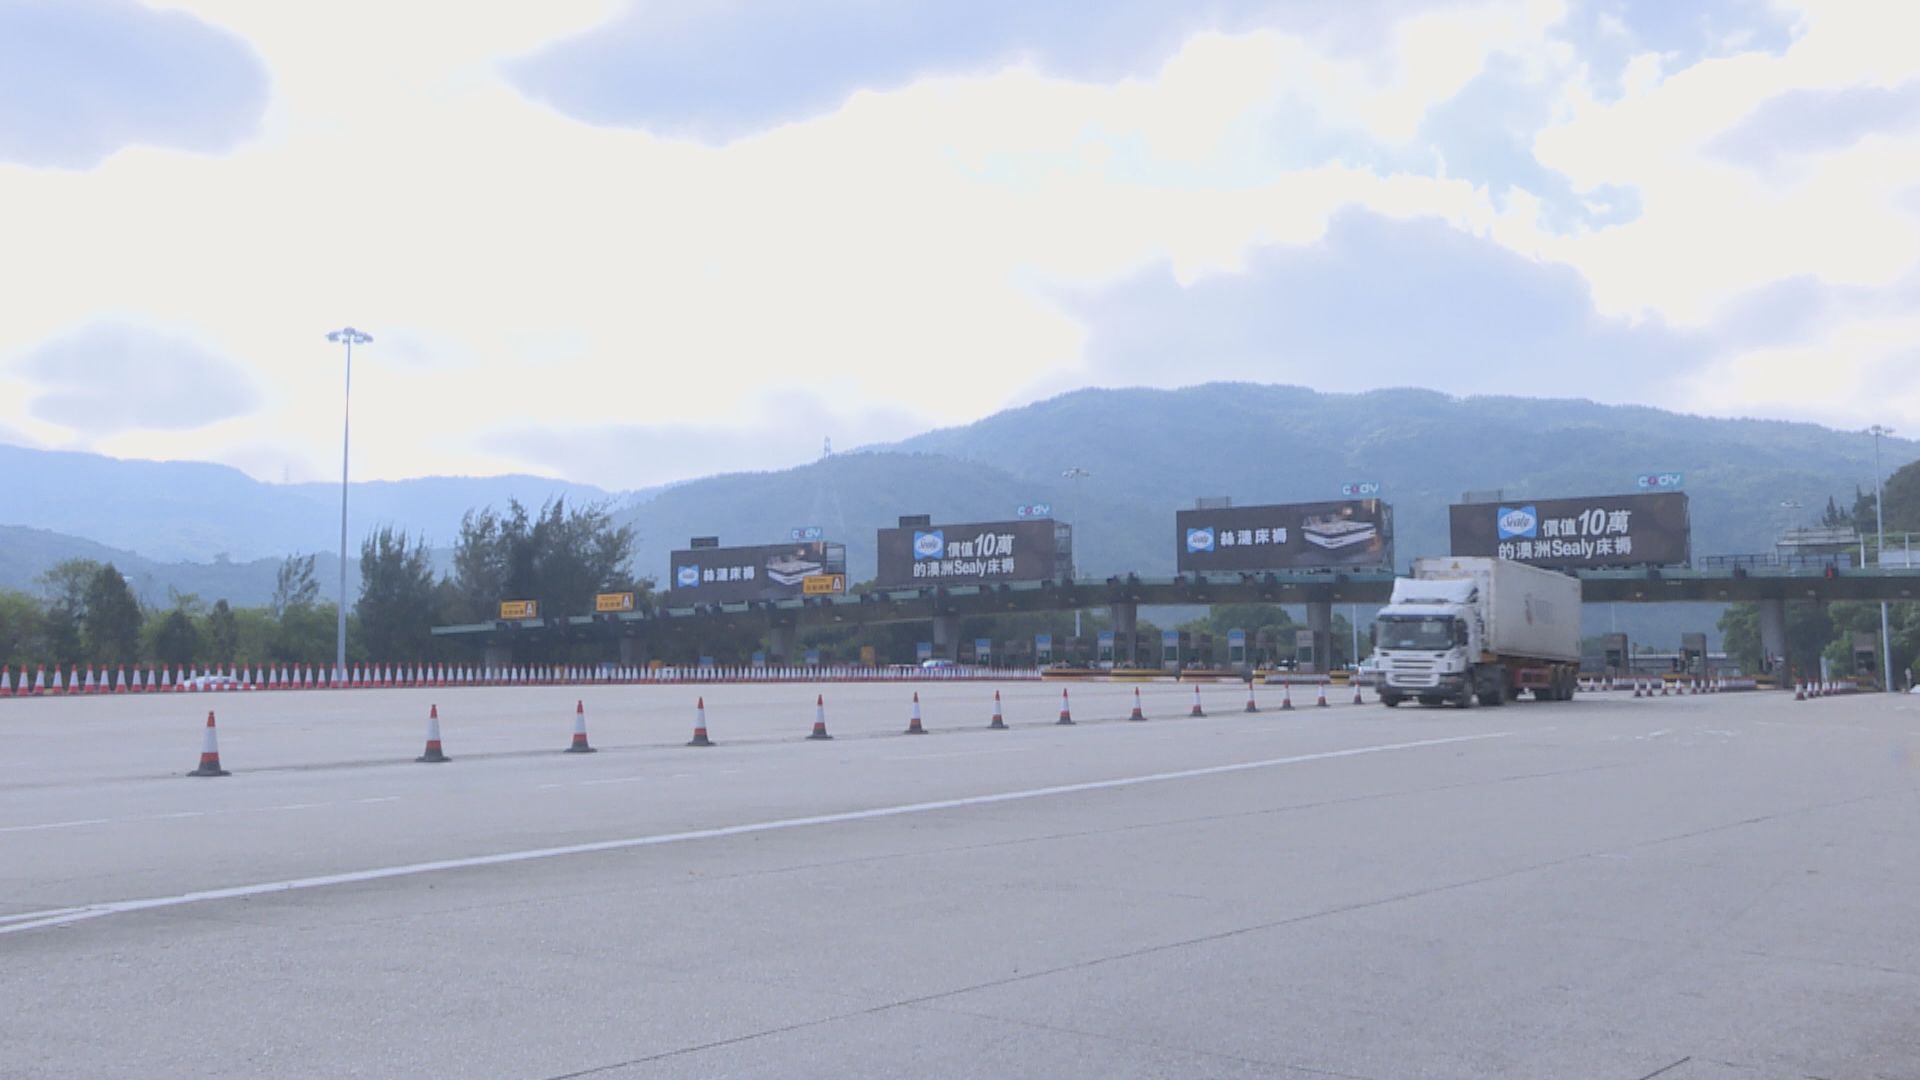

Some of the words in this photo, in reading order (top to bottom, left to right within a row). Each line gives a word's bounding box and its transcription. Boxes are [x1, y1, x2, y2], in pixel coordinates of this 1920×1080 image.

[1542, 508, 1632, 537] 價值10萬
[947, 532, 1015, 558] 價值10萬
